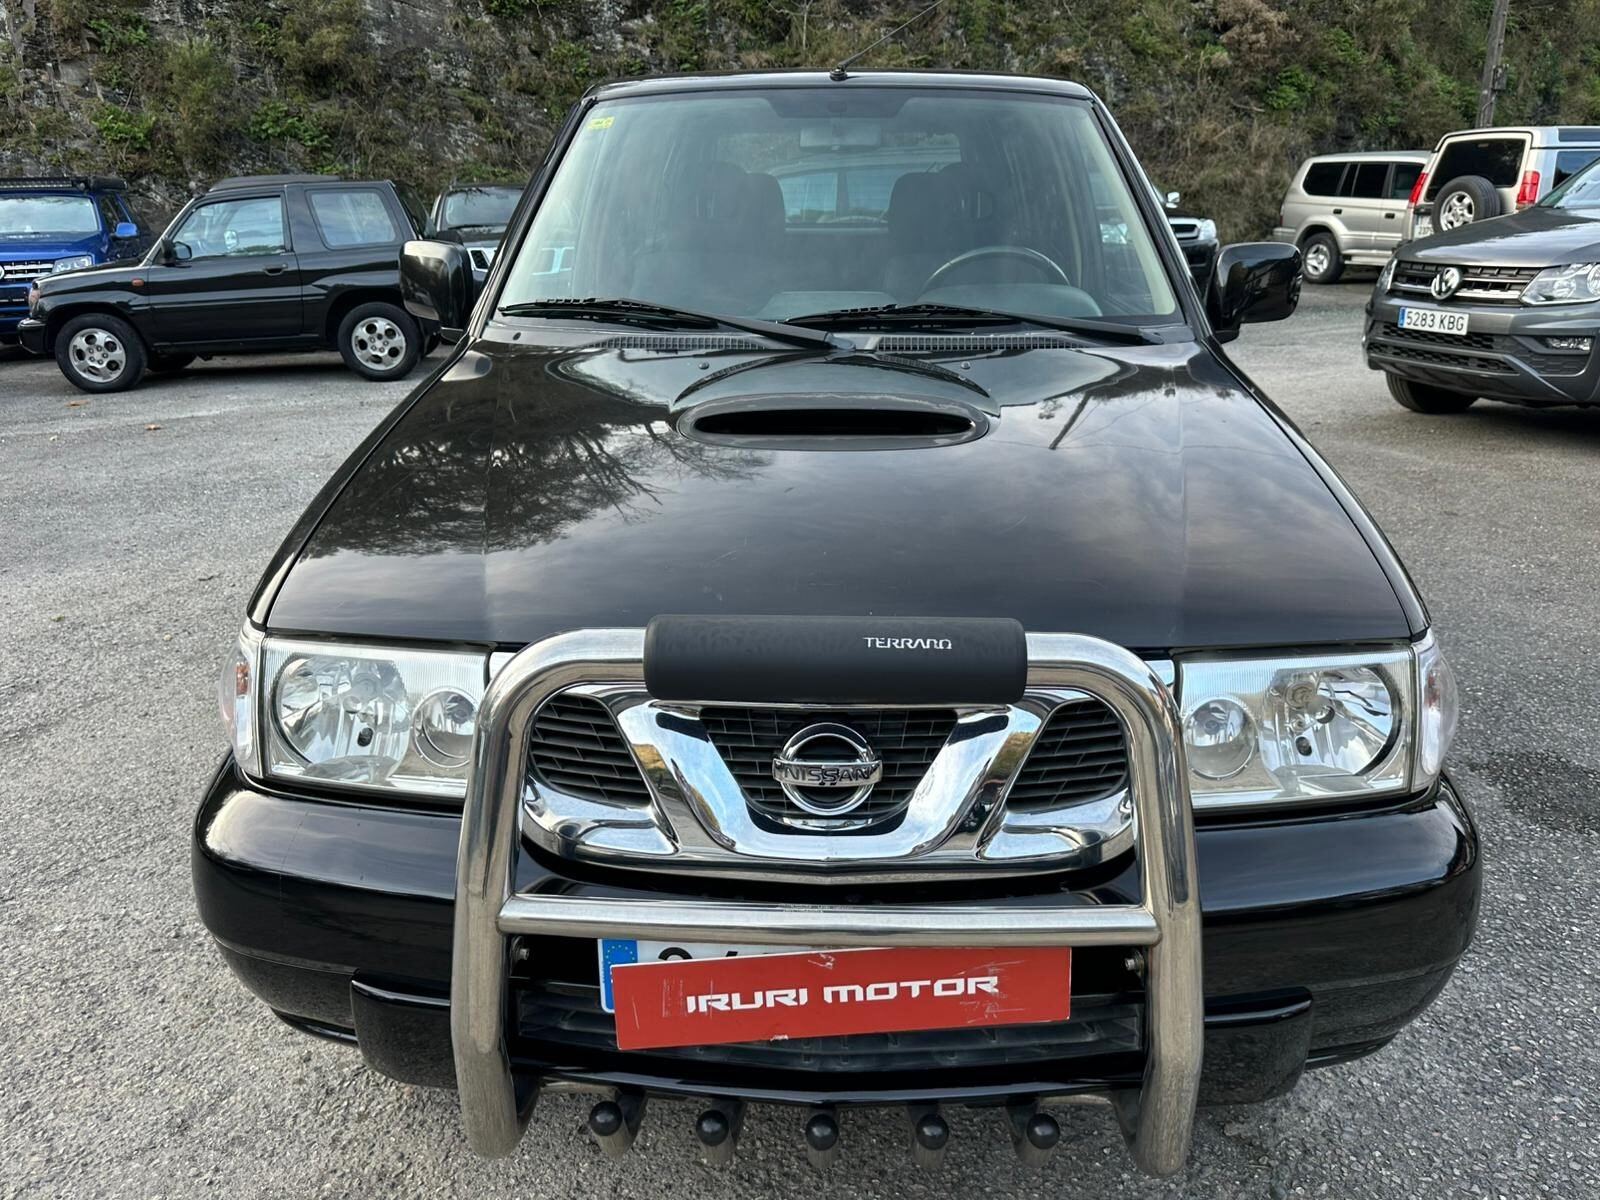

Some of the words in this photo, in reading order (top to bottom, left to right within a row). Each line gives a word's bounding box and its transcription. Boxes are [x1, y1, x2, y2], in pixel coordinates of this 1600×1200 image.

[1406, 310, 1436, 328] 5283
[1438, 314, 1465, 331] KBG
[863, 637, 953, 650] TERRANO
[782, 766, 873, 783] NISSAN
[686, 988, 808, 1013] IRURI
[823, 975, 999, 1004] MOTOR
